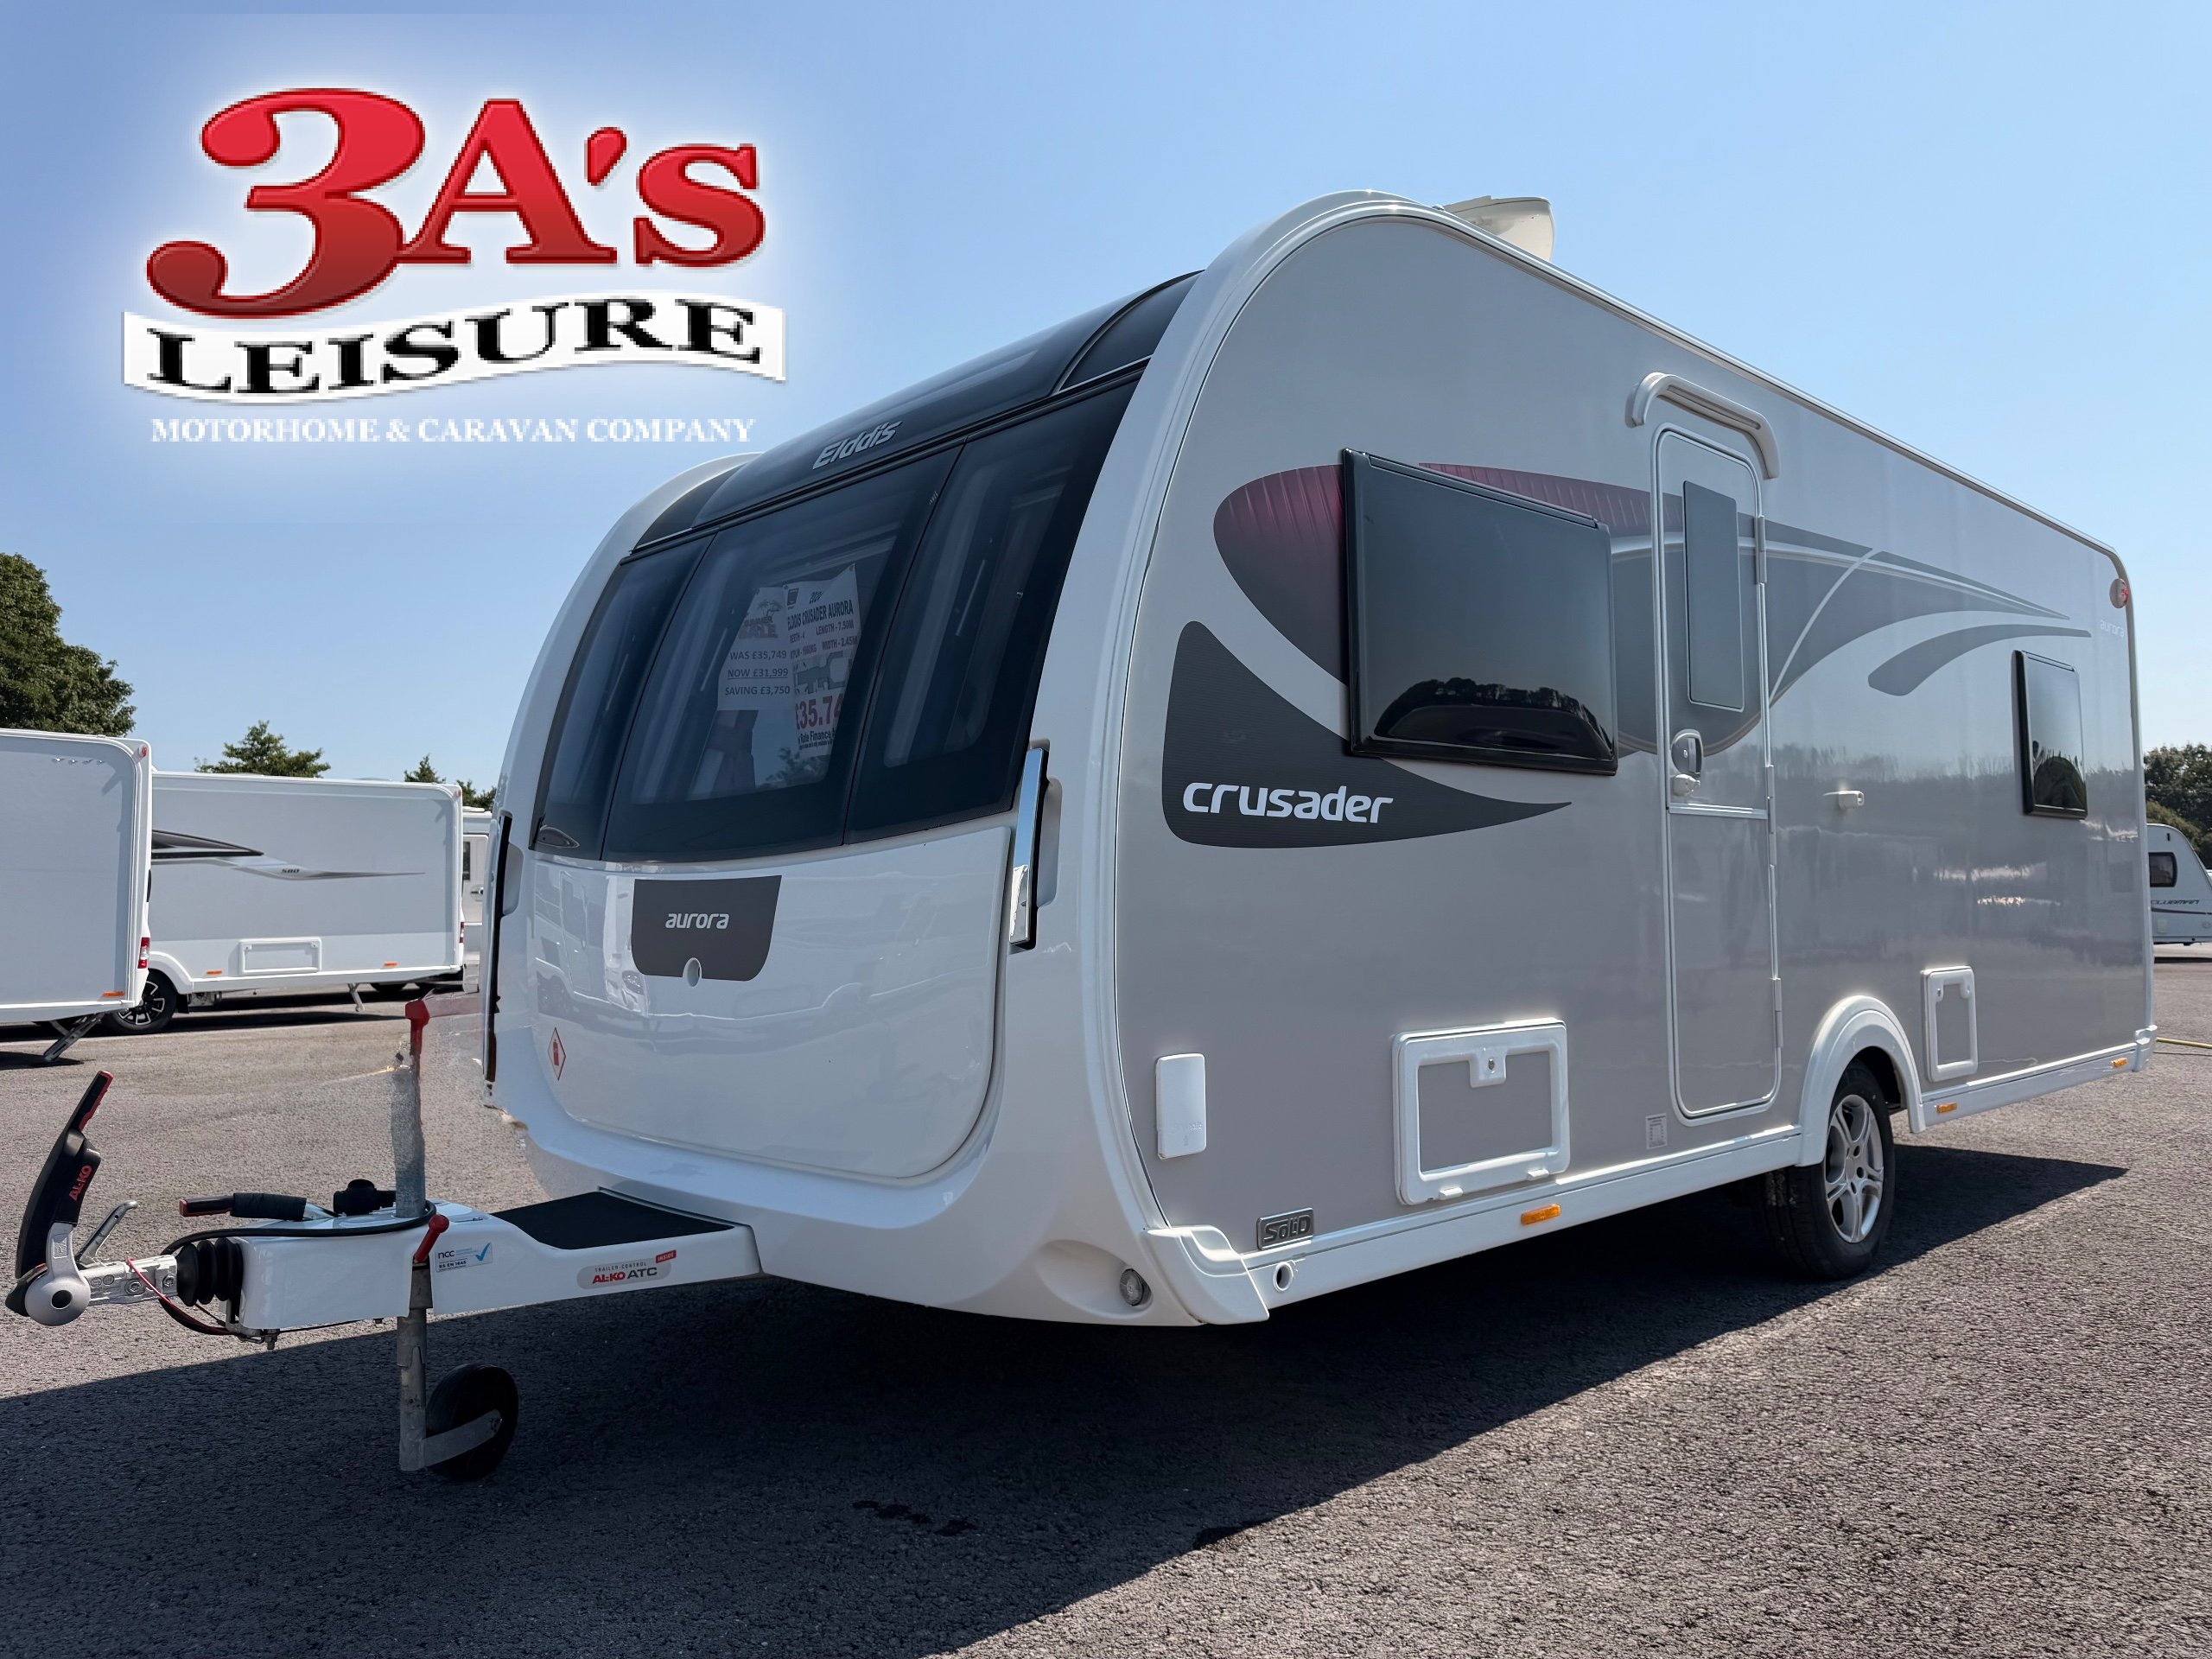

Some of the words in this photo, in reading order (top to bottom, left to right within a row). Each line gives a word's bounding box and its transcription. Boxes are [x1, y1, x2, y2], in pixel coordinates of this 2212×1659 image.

[812, 421, 904, 470] Elddis
[787, 613, 802, 632] ELDDIS
[802, 605, 827, 626] CRUSADER
[828, 599, 854, 620] AURORA
[816, 622, 835, 636] LENGTH
[838, 619, 855, 632] 7.50M
[729, 651, 749, 660] WAS
[752, 650, 787, 661] £35,749
[728, 668, 750, 678] NOW
[753, 667, 789, 678] £31,999
[725, 686, 758, 696] SAVING
[760, 685, 791, 696] £3,750
[810, 729, 831, 741] Finance
[1183, 782, 1394, 823] crusader
[664, 912, 729, 929] aurora
[69, 1165, 92, 1201] AL-KO
[438, 1249, 454, 1259] ncc
[658, 1251, 674, 1262] INSIDE
[627, 1267, 658, 1279] ATC
